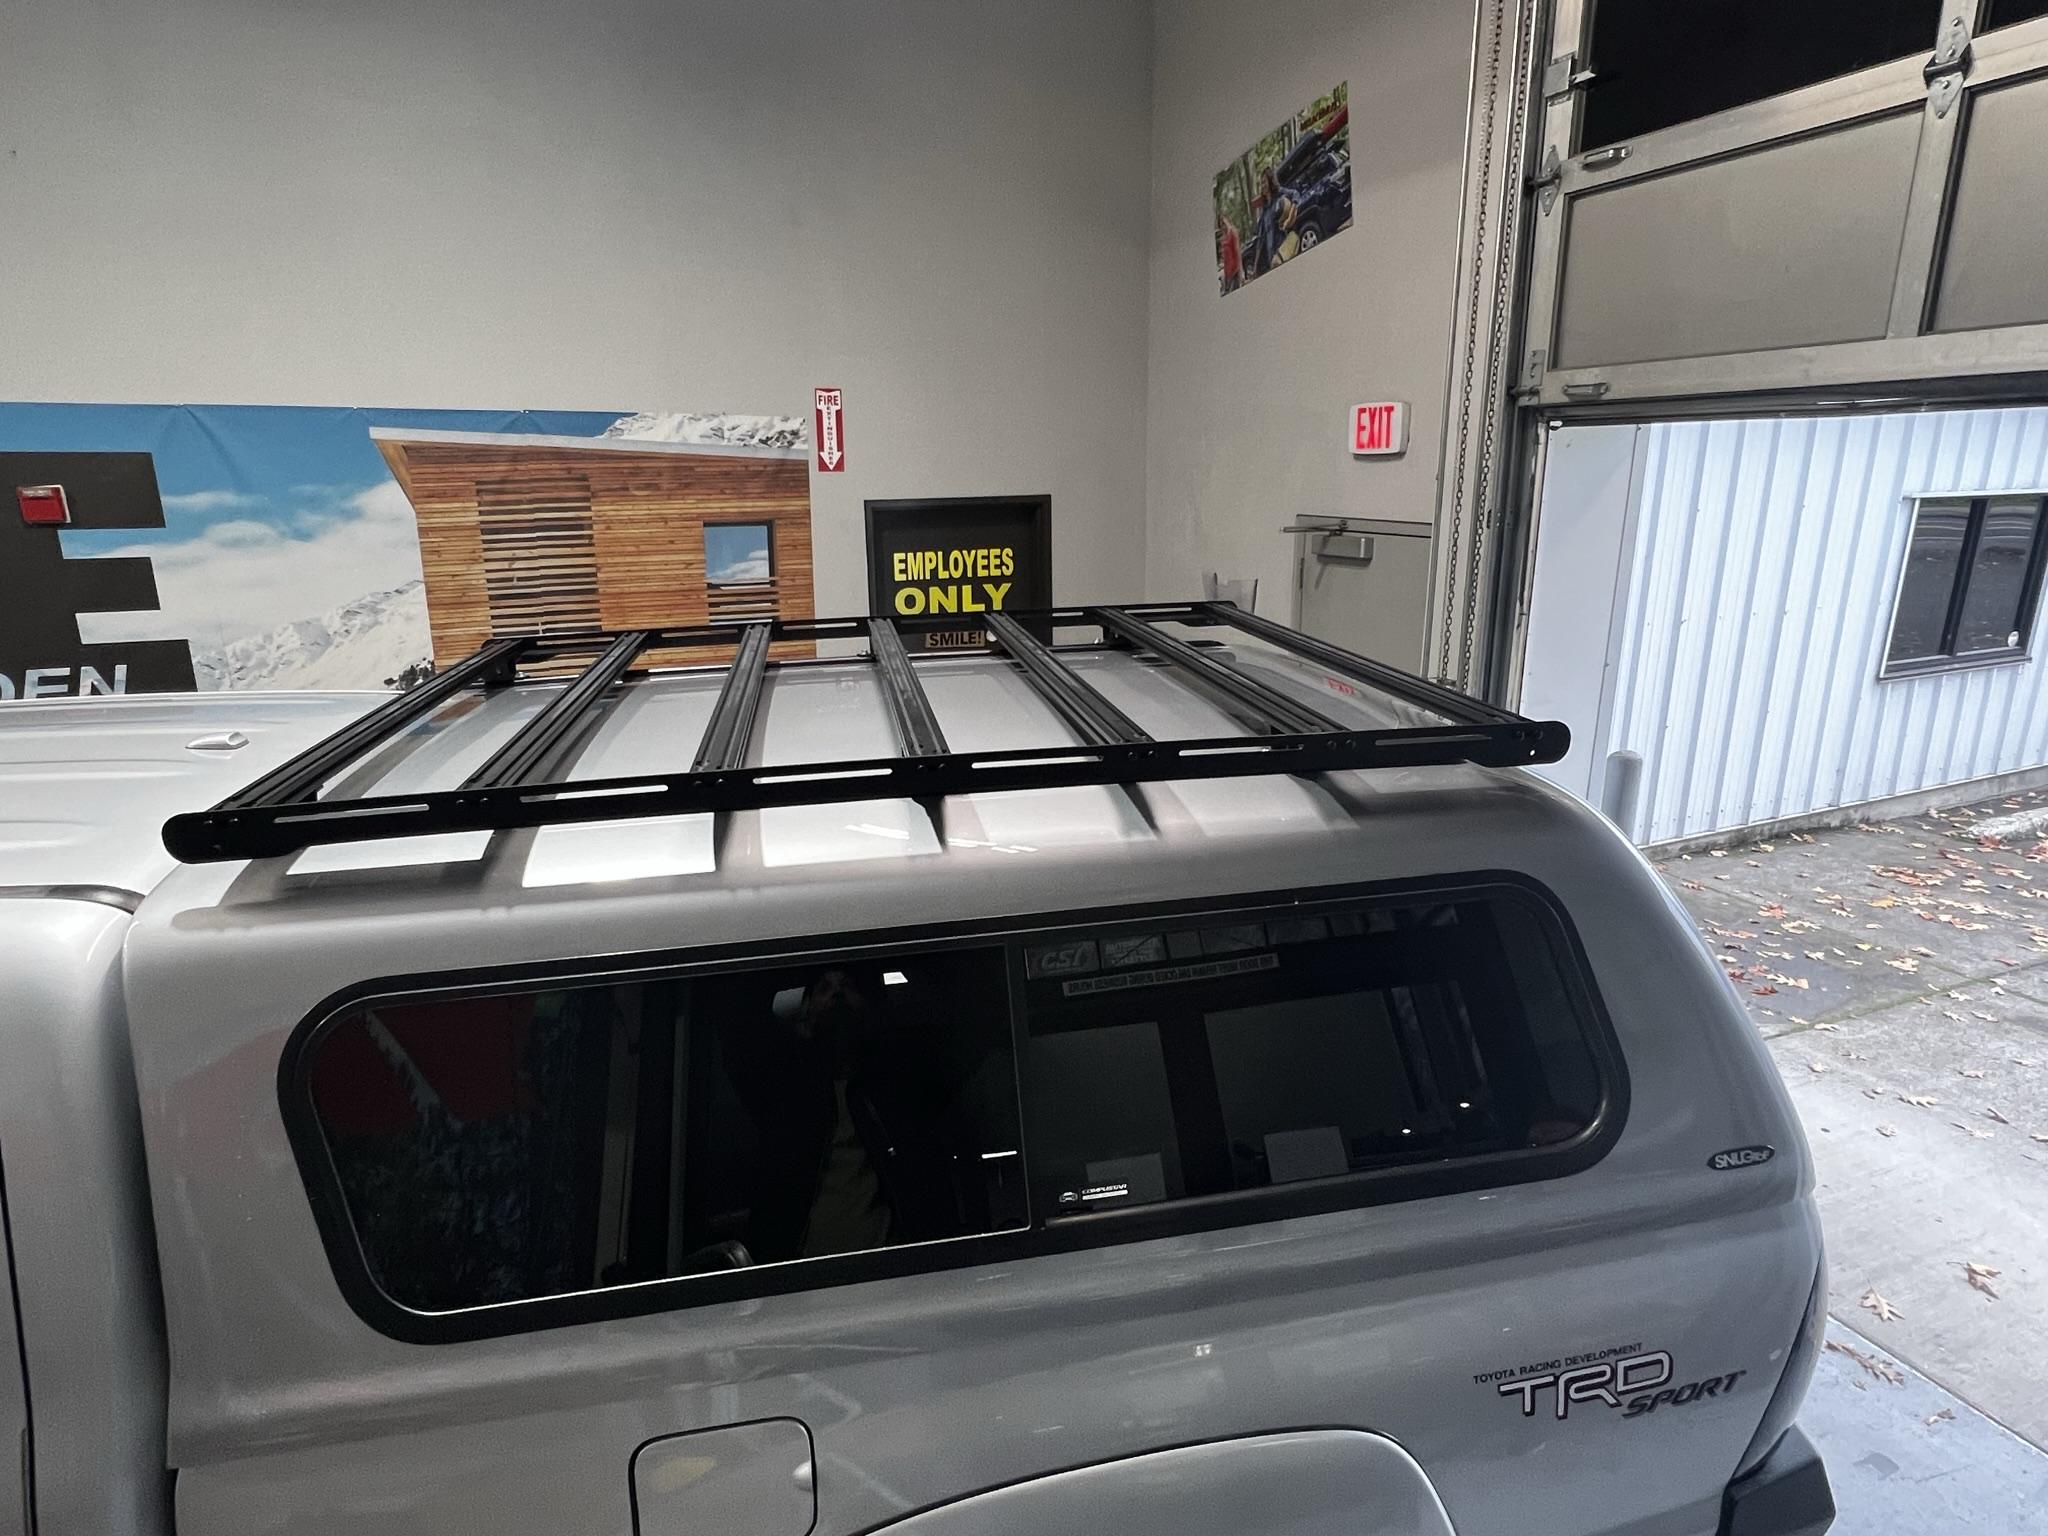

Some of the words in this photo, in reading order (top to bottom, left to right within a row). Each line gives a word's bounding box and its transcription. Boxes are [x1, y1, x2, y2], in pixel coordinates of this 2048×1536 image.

[818, 395, 839, 406] FIRE
[1356, 406, 1394, 449] EXIT
[893, 548, 1014, 581] EMPLOYEES
[894, 583, 1012, 615] ONLY
[929, 631, 982, 646] SMILE!
[1473, 1371, 1515, 1384] TOYOTA
[1520, 1361, 1562, 1376] RACING
[1565, 1343, 1643, 1366] DEVELOPMENT
[1498, 1350, 1673, 1420] TRD
[1622, 1370, 1746, 1418] SPORT
